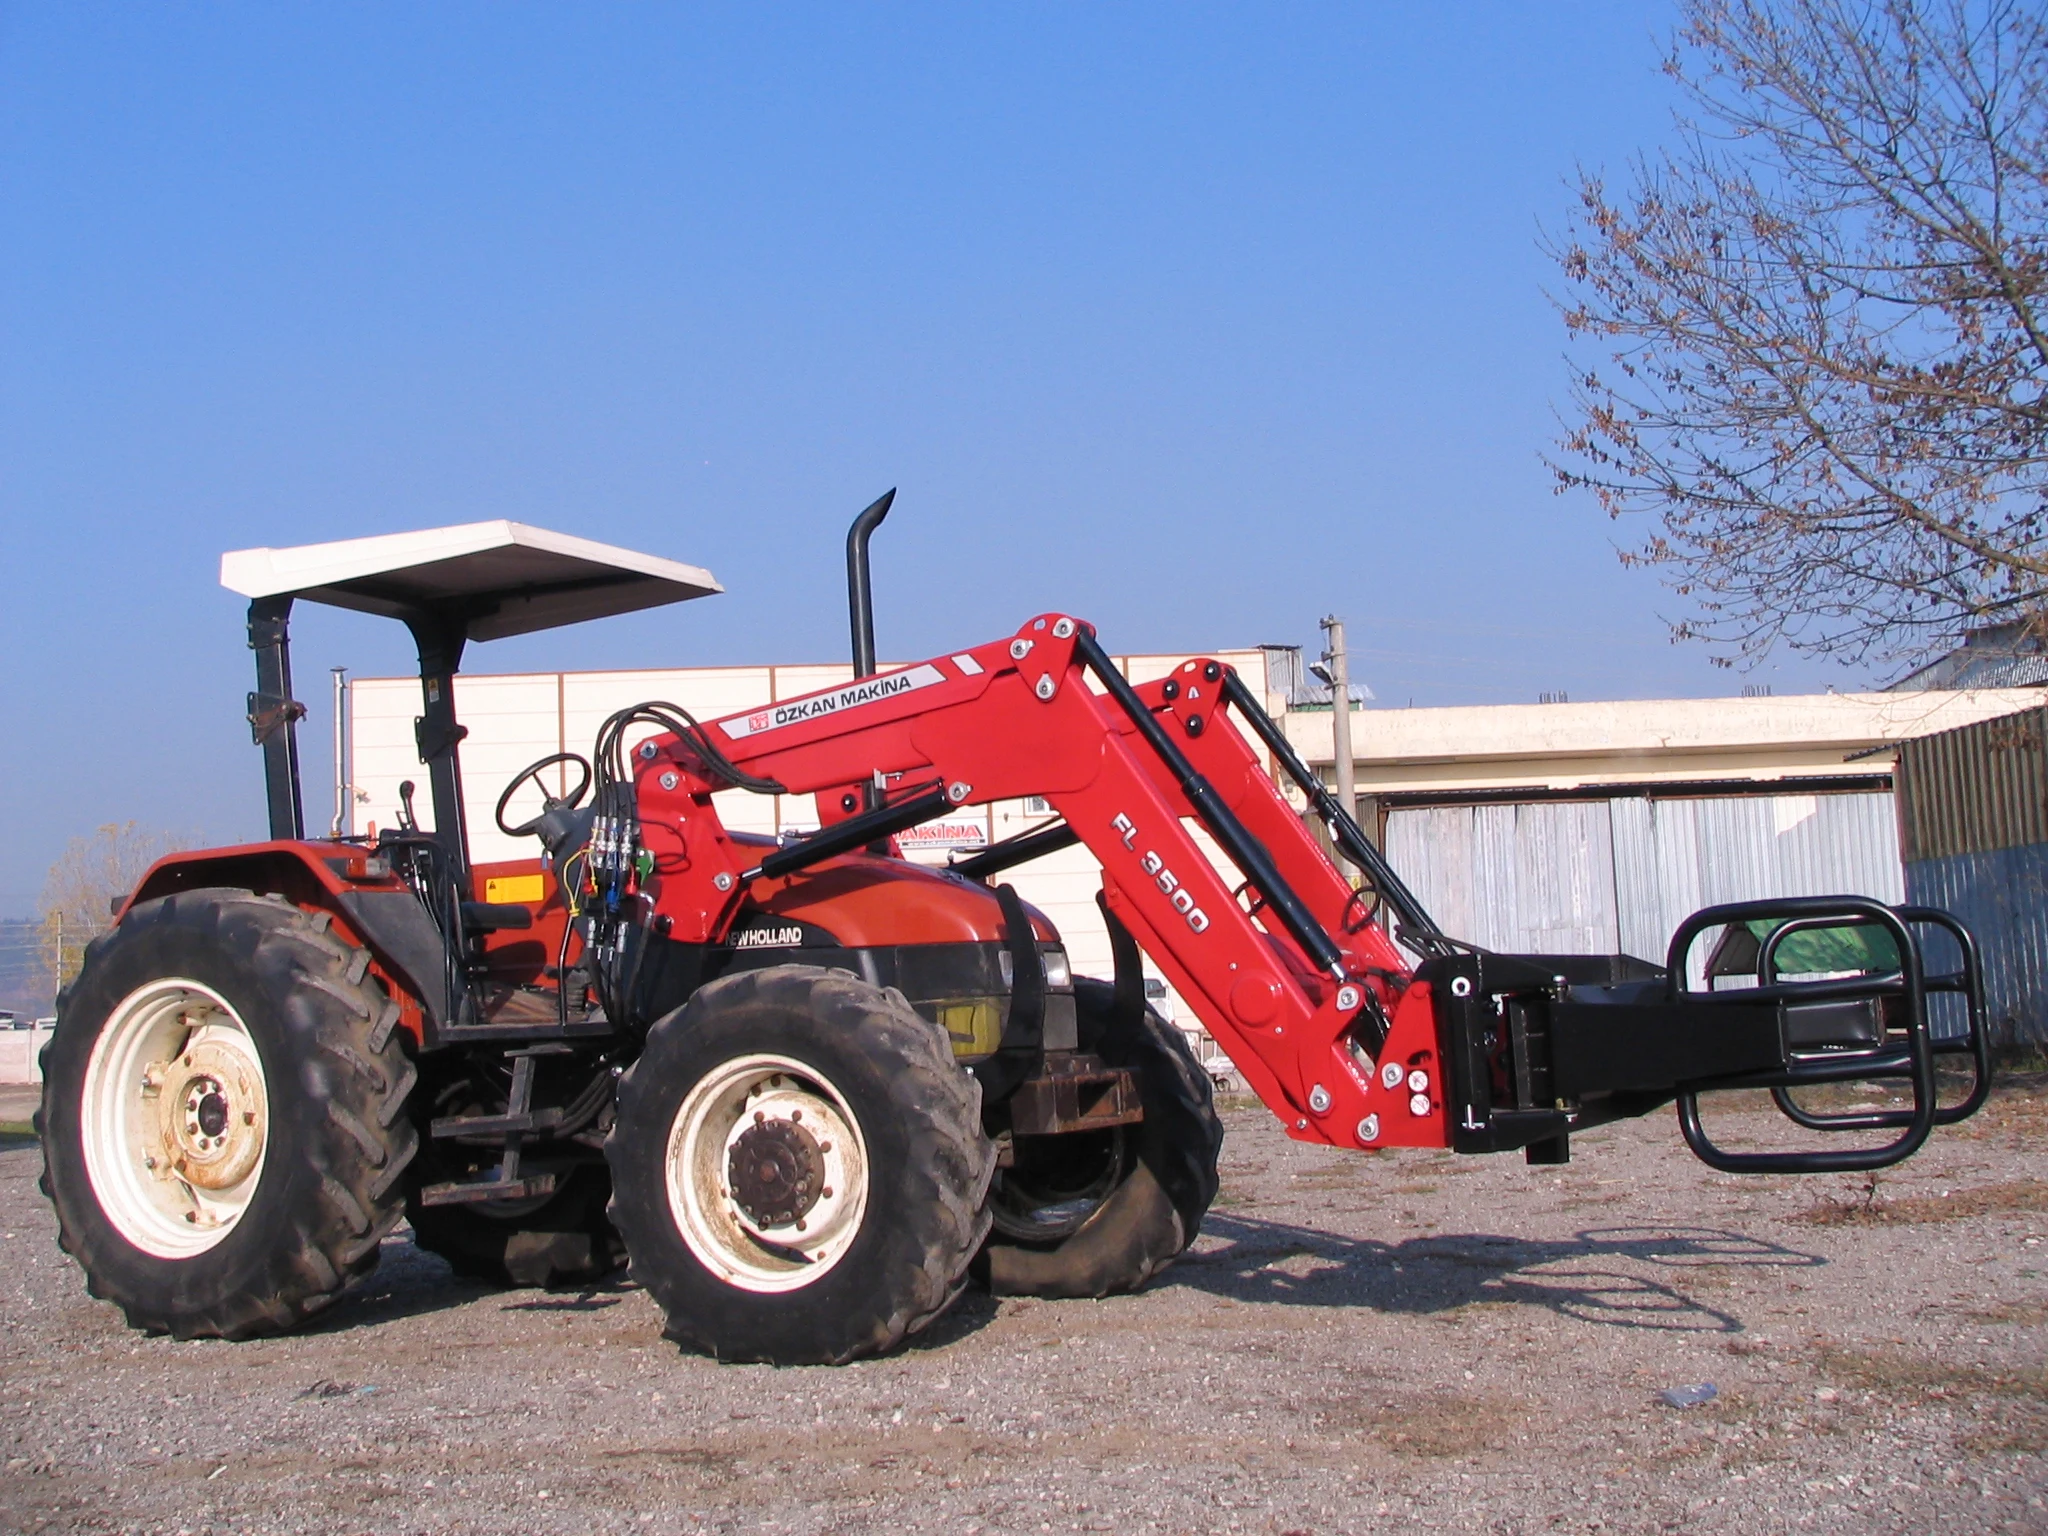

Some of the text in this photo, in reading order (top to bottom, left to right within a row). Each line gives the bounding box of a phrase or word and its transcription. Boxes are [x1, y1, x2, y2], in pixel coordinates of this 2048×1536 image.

[775, 697, 836, 725] ÖZKAN
[840, 676, 912, 707] MAKİNA
[1110, 812, 1211, 935] FL 3500
[726, 926, 802, 946] NEW HOLLAND
